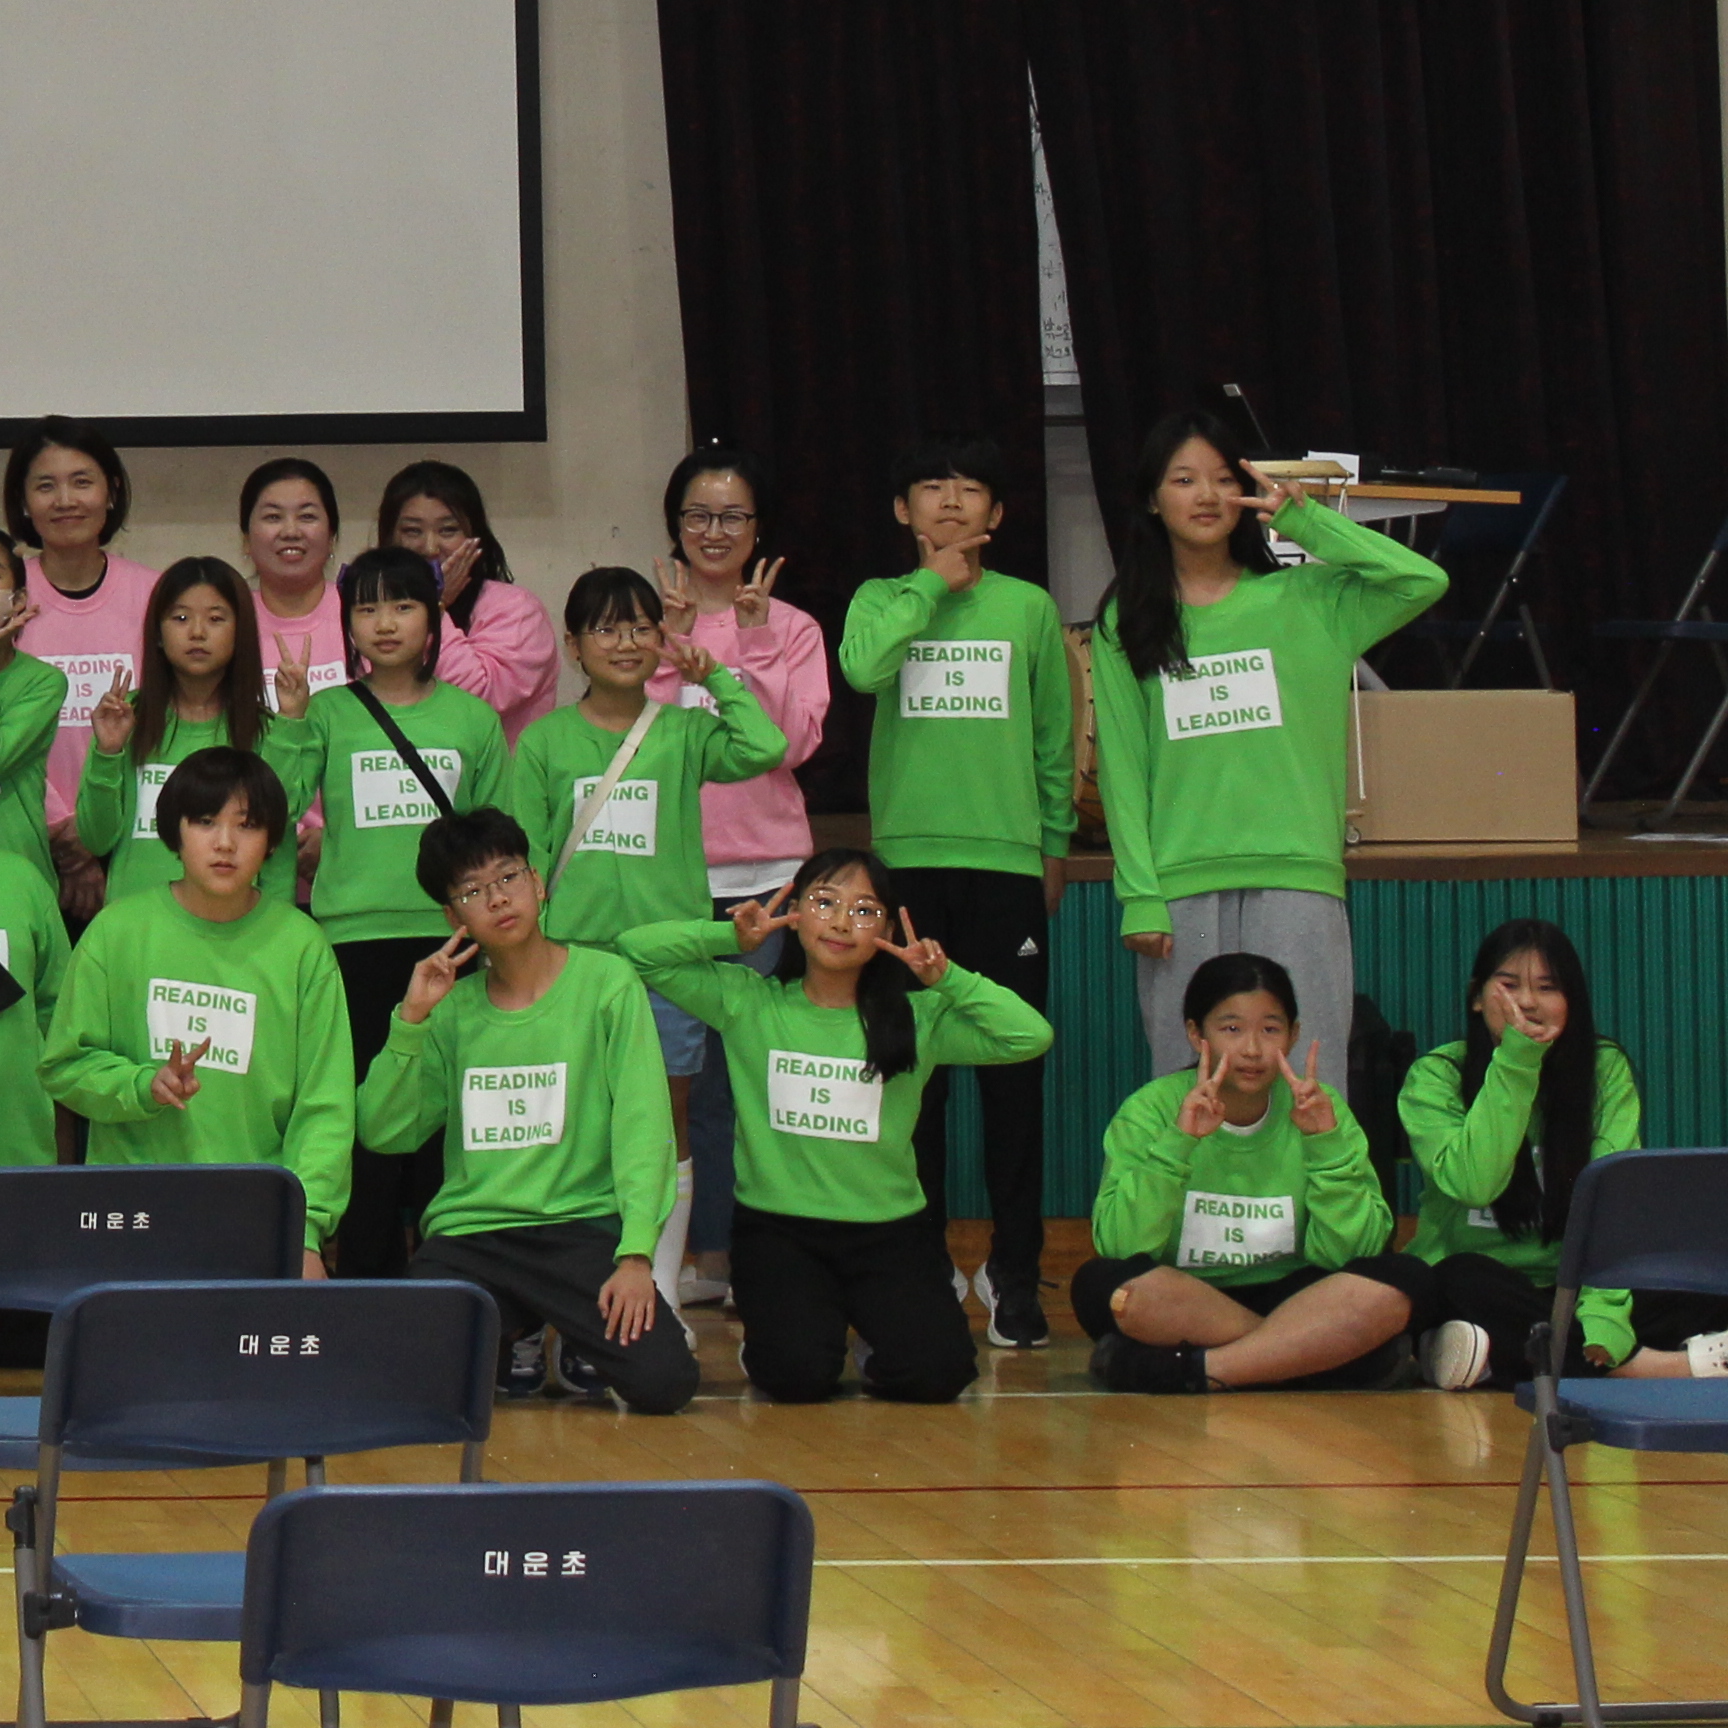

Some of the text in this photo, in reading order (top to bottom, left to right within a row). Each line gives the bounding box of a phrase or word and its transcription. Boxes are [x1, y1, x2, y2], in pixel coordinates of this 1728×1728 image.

[908, 646, 1003, 663] READING
[945, 671, 965, 687] IS
[76, 683, 93, 698] IS
[1210, 685, 1229, 701] IS
[908, 696, 1003, 712] LEADING
[1177, 706, 1271, 732] LEADING
[399, 778, 418, 794] IS
[364, 801, 443, 821] LEADIN
[152, 986, 248, 1014] READING
[187, 1016, 208, 1033] IS
[469, 1072, 557, 1091] READING
[810, 1087, 831, 1105] IS
[507, 1099, 526, 1116] IS
[776, 1109, 869, 1136] LEADING
[471, 1122, 553, 1144] LEADING
[1195, 1198, 1284, 1219] READING
[79, 1211, 150, 1230] 대운초
[1225, 1228, 1244, 1243] IS
[239, 1334, 321, 1355] 대운초
[483, 1550, 586, 1576] 대운초
